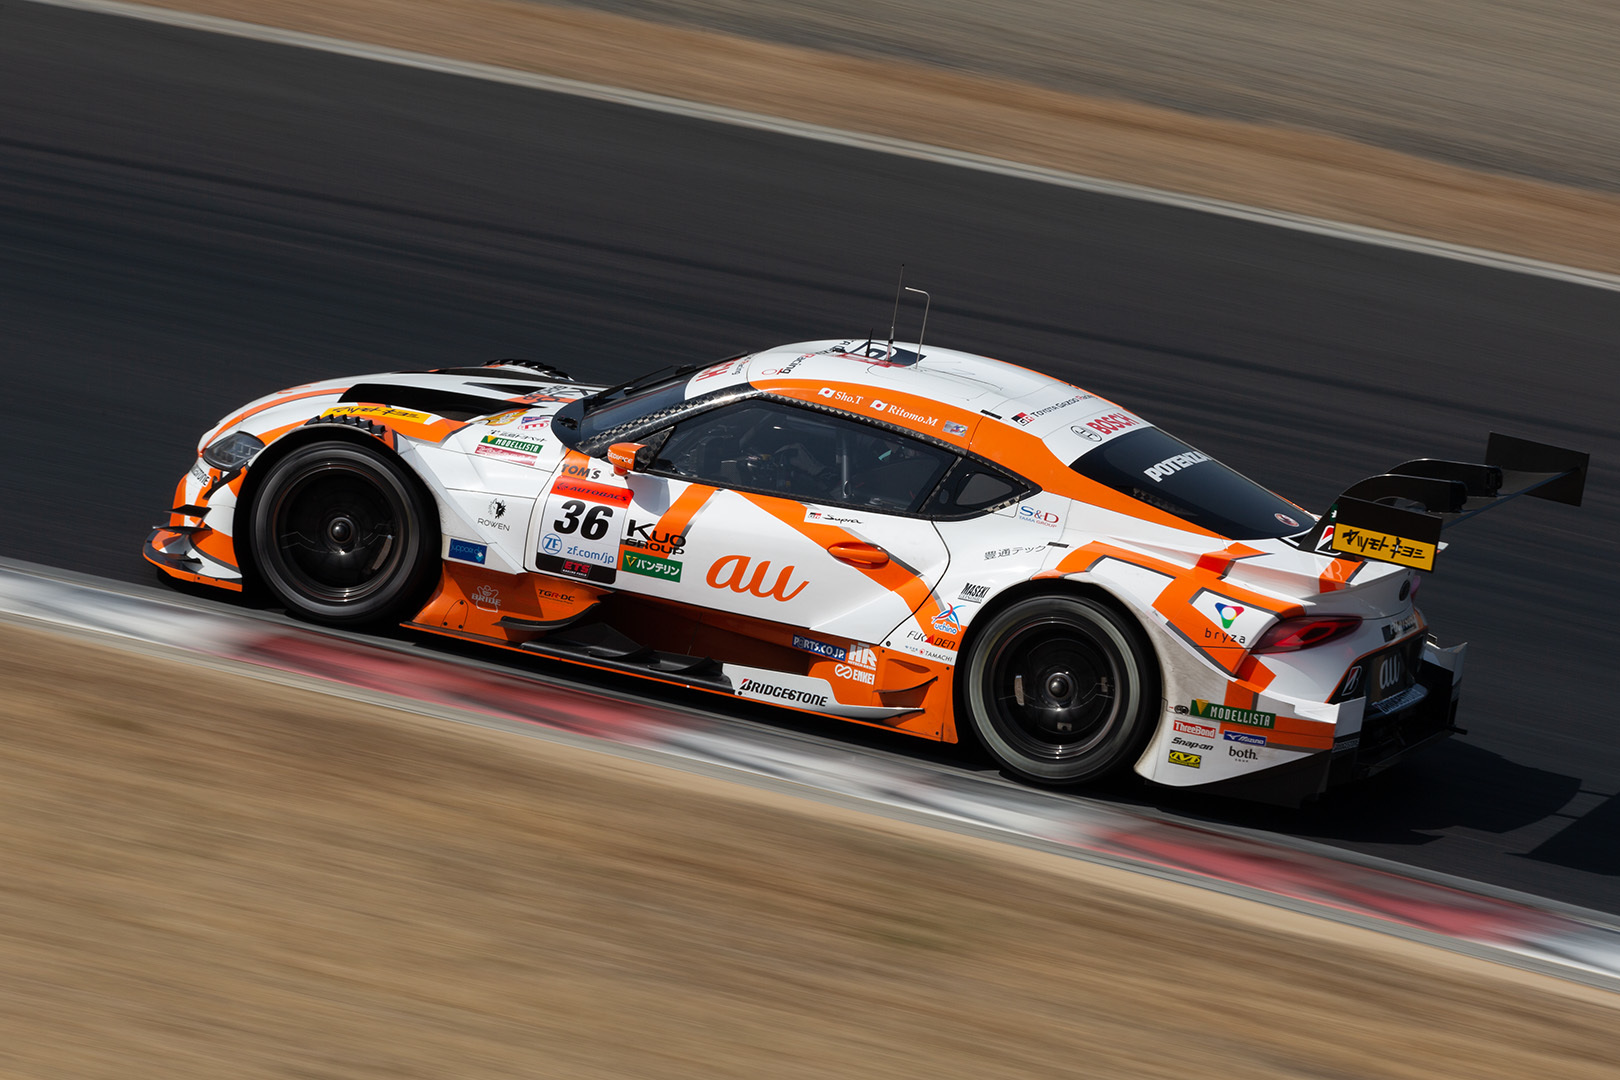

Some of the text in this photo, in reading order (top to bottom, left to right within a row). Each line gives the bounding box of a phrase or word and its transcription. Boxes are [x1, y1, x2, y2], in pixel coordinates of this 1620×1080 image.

[834, 391, 939, 427] Sho.T Ritomo.M
[1086, 412, 1140, 435] BOSCH
[495, 438, 540, 452] MODELLISTA
[562, 464, 602, 480] TOM'S
[1144, 450, 1213, 483] POTENZA
[569, 486, 629, 502] AUTOBACS
[553, 500, 614, 540] 36
[822, 514, 864, 525] Supra
[1019, 505, 1060, 524] S&D
[477, 518, 510, 532] ROWEN
[627, 519, 687, 548] KUO
[543, 535, 562, 553] ZF
[624, 538, 685, 556] GROUP
[984, 545, 1046, 560] 豊通テック
[1342, 528, 1426, 560] マツモトキヨシ
[566, 545, 614, 564] zf.com/jp
[564, 560, 590, 572] ETS
[636, 558, 680, 576] バンテリン
[706, 554, 810, 602] au
[960, 582, 991, 598] MASEKI
[472, 593, 501, 606] BRIDE
[934, 622, 958, 634] uchino
[1204, 628, 1246, 644] bryza
[925, 651, 953, 662] TAMACHI
[852, 669, 875, 686] ENKEI
[740, 678, 828, 707] BRIDGESTONE
[1210, 705, 1271, 727] MODELLISTA
[1175, 721, 1216, 738] ThreeBond
[1171, 737, 1214, 751] Snap-on
